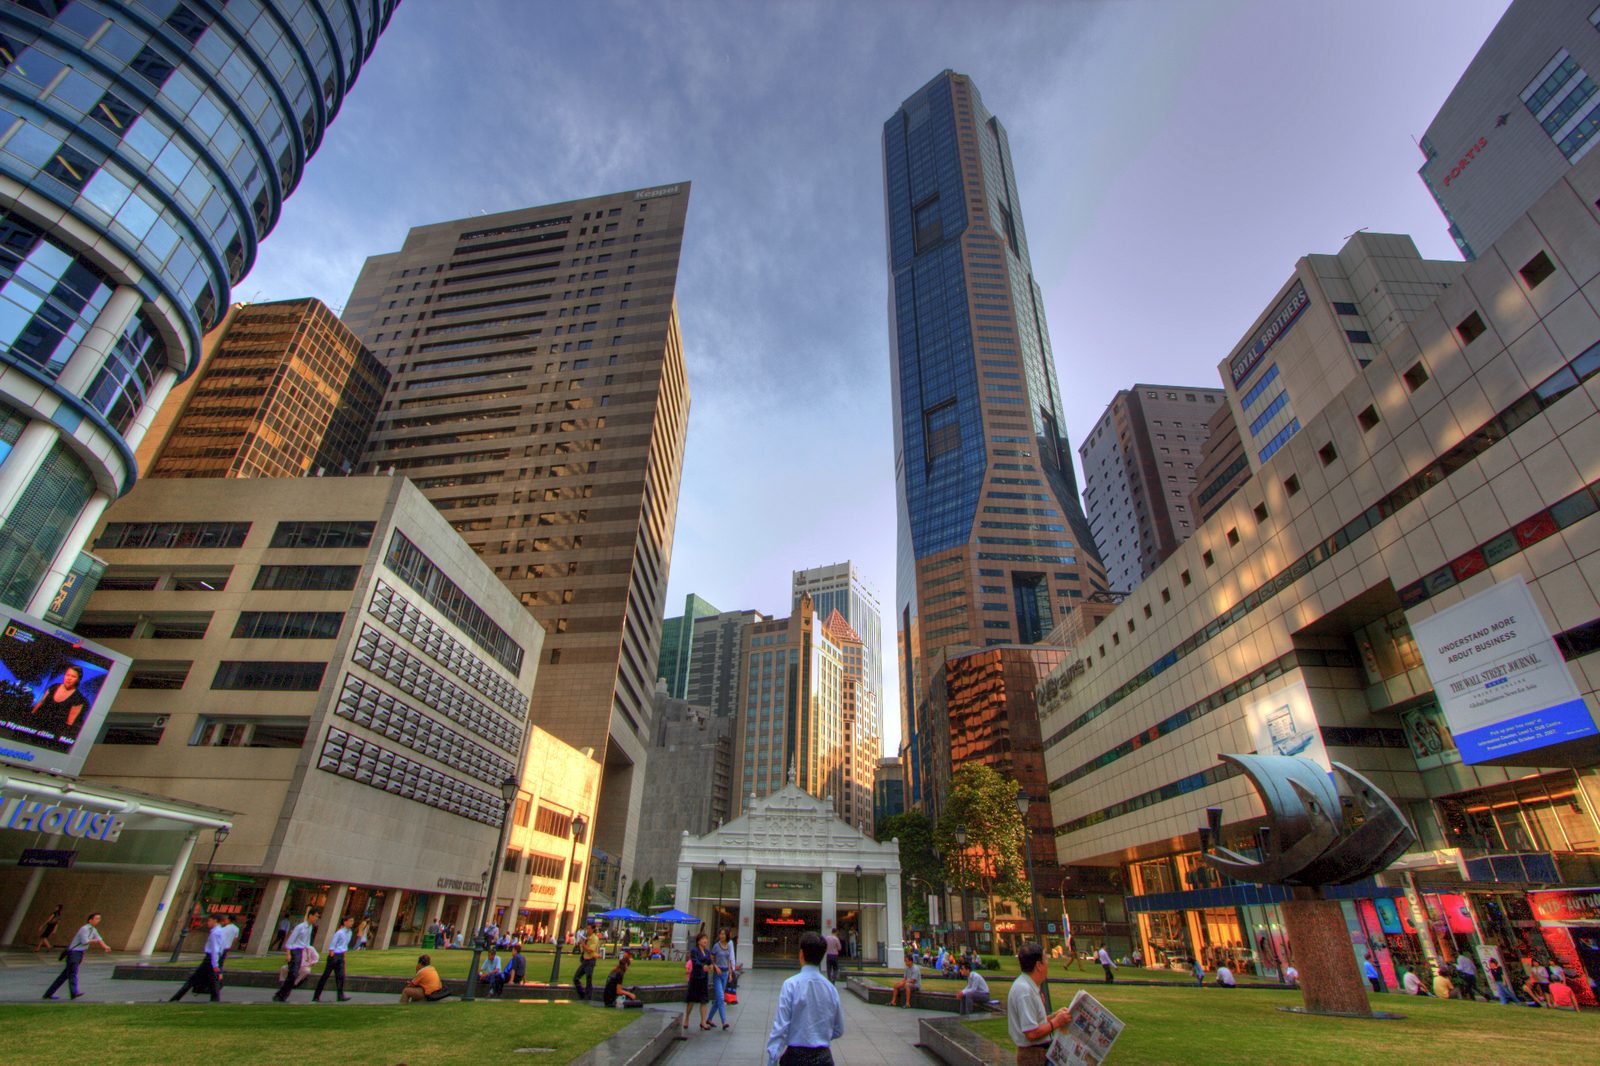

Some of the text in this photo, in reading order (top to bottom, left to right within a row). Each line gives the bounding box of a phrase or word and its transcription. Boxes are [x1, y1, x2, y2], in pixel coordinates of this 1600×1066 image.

[1443, 137, 1488, 186] FORTIS
[635, 185, 679, 199] Keppel
[1233, 290, 1306, 380] ROYAL BROTHERS
[1438, 616, 1517, 654] UNDERSTAND MORE
[1447, 630, 1517, 664] ABOUT BUSINESS
[1450, 679, 1464, 693] THE
[1464, 673, 1481, 689] WALL
[1481, 664, 1508, 684] STREET
[8, 799, 125, 843] HOUSE
[437, 877, 481, 891] CLIFFORD CENTRE
